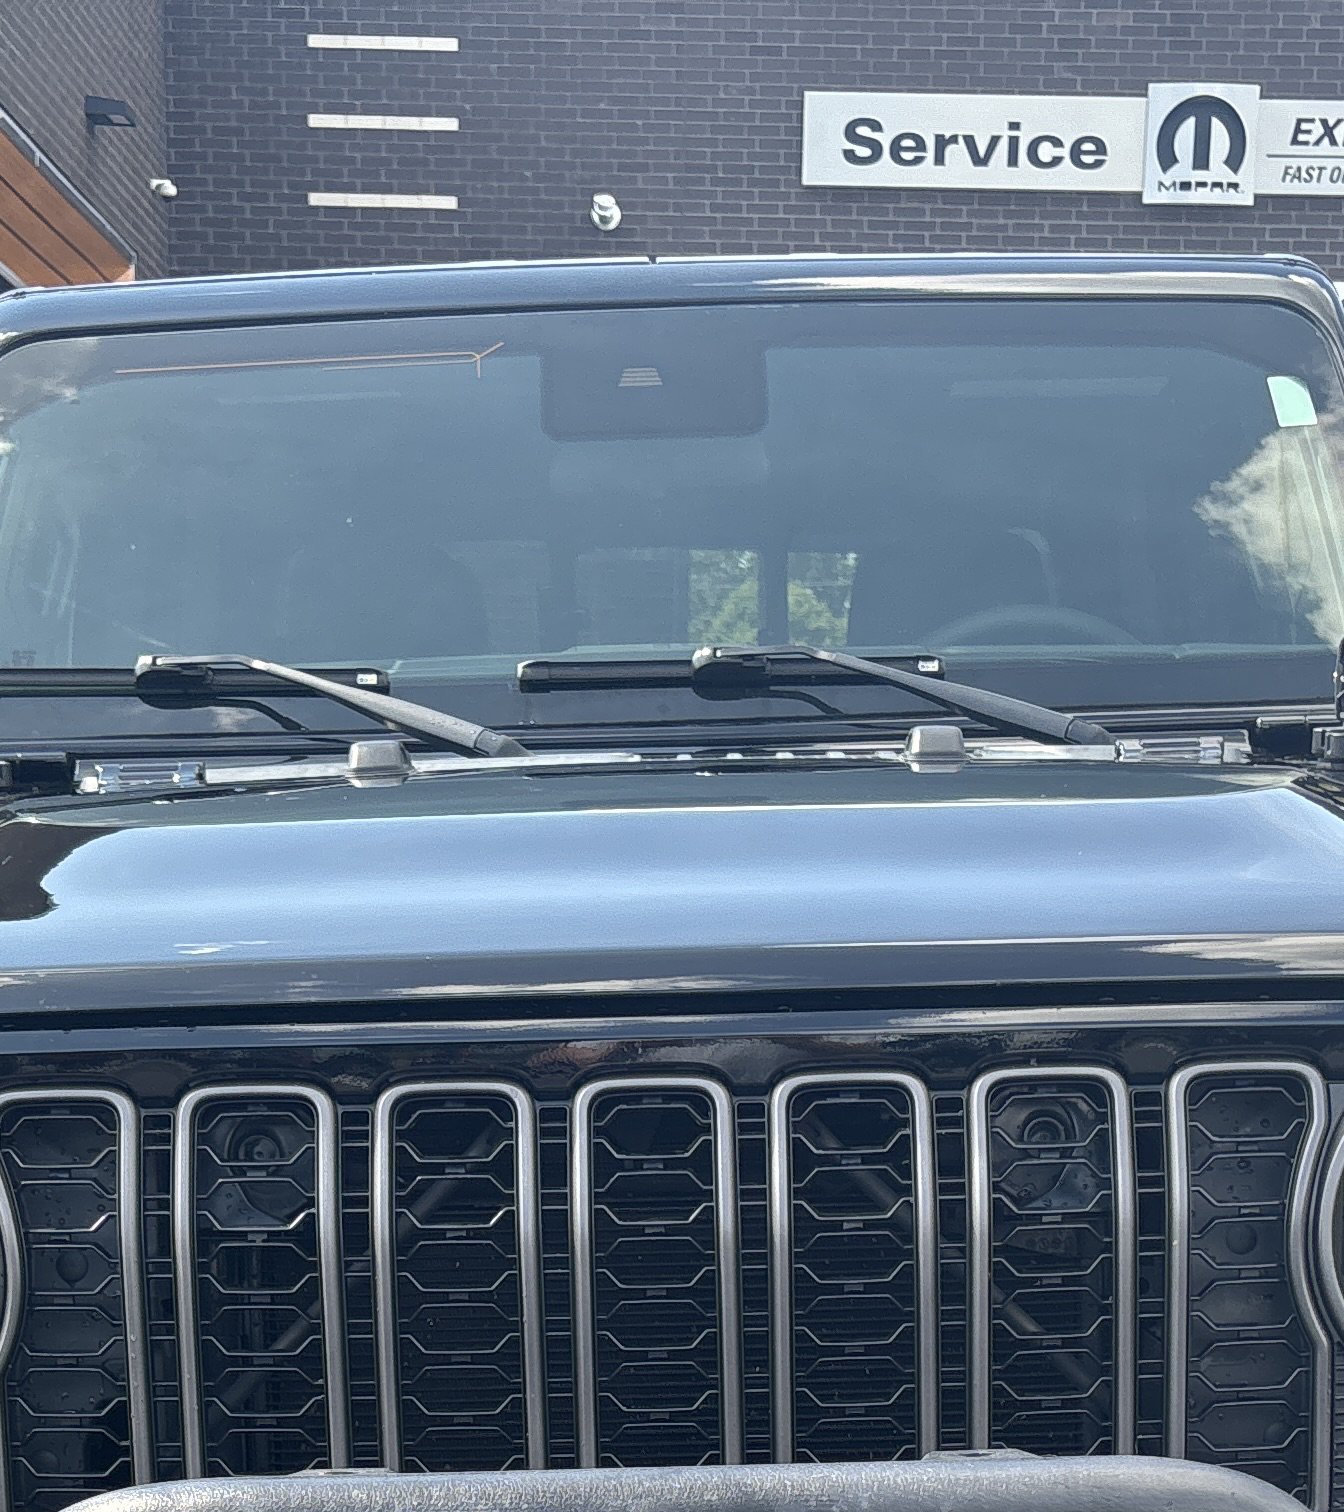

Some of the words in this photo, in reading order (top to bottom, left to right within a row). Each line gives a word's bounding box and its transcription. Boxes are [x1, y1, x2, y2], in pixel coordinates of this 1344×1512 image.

[842, 117, 1108, 170] Service
[1281, 165, 1327, 184] FAST
[1158, 180, 1241, 194] MOPAR
